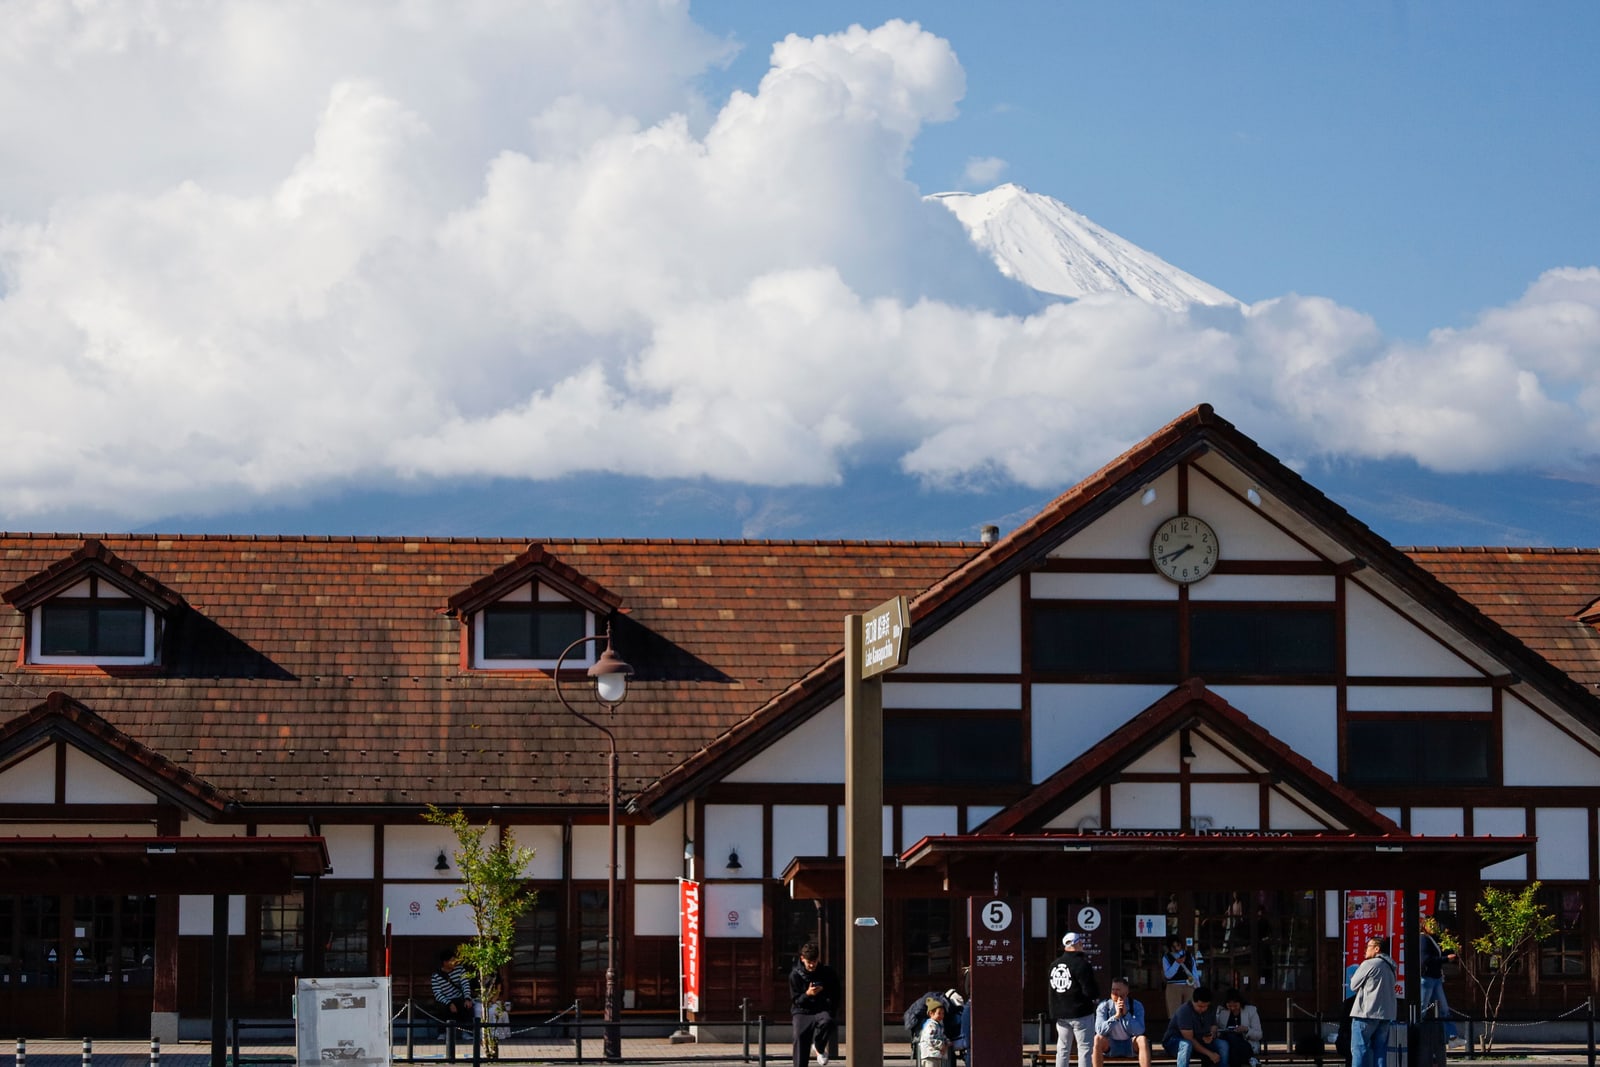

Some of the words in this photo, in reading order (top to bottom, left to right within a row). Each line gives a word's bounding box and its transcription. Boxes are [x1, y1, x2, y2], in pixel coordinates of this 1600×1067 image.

[1170, 524, 1177, 534] 11
[1180, 522, 1189, 530] 12
[1162, 532, 1169, 542] 10
[1202, 533, 1208, 542] 2
[1158, 545, 1164, 554] 9
[1206, 546, 1212, 554] 3
[1203, 556, 1209, 565] 4
[1171, 566, 1177, 574] 7
[1182, 568, 1188, 577] 6
[1194, 566, 1200, 575] 5
[686, 888, 698, 930] TAX
[990, 904, 1003, 924] 5
[1084, 909, 1094, 924] 2
